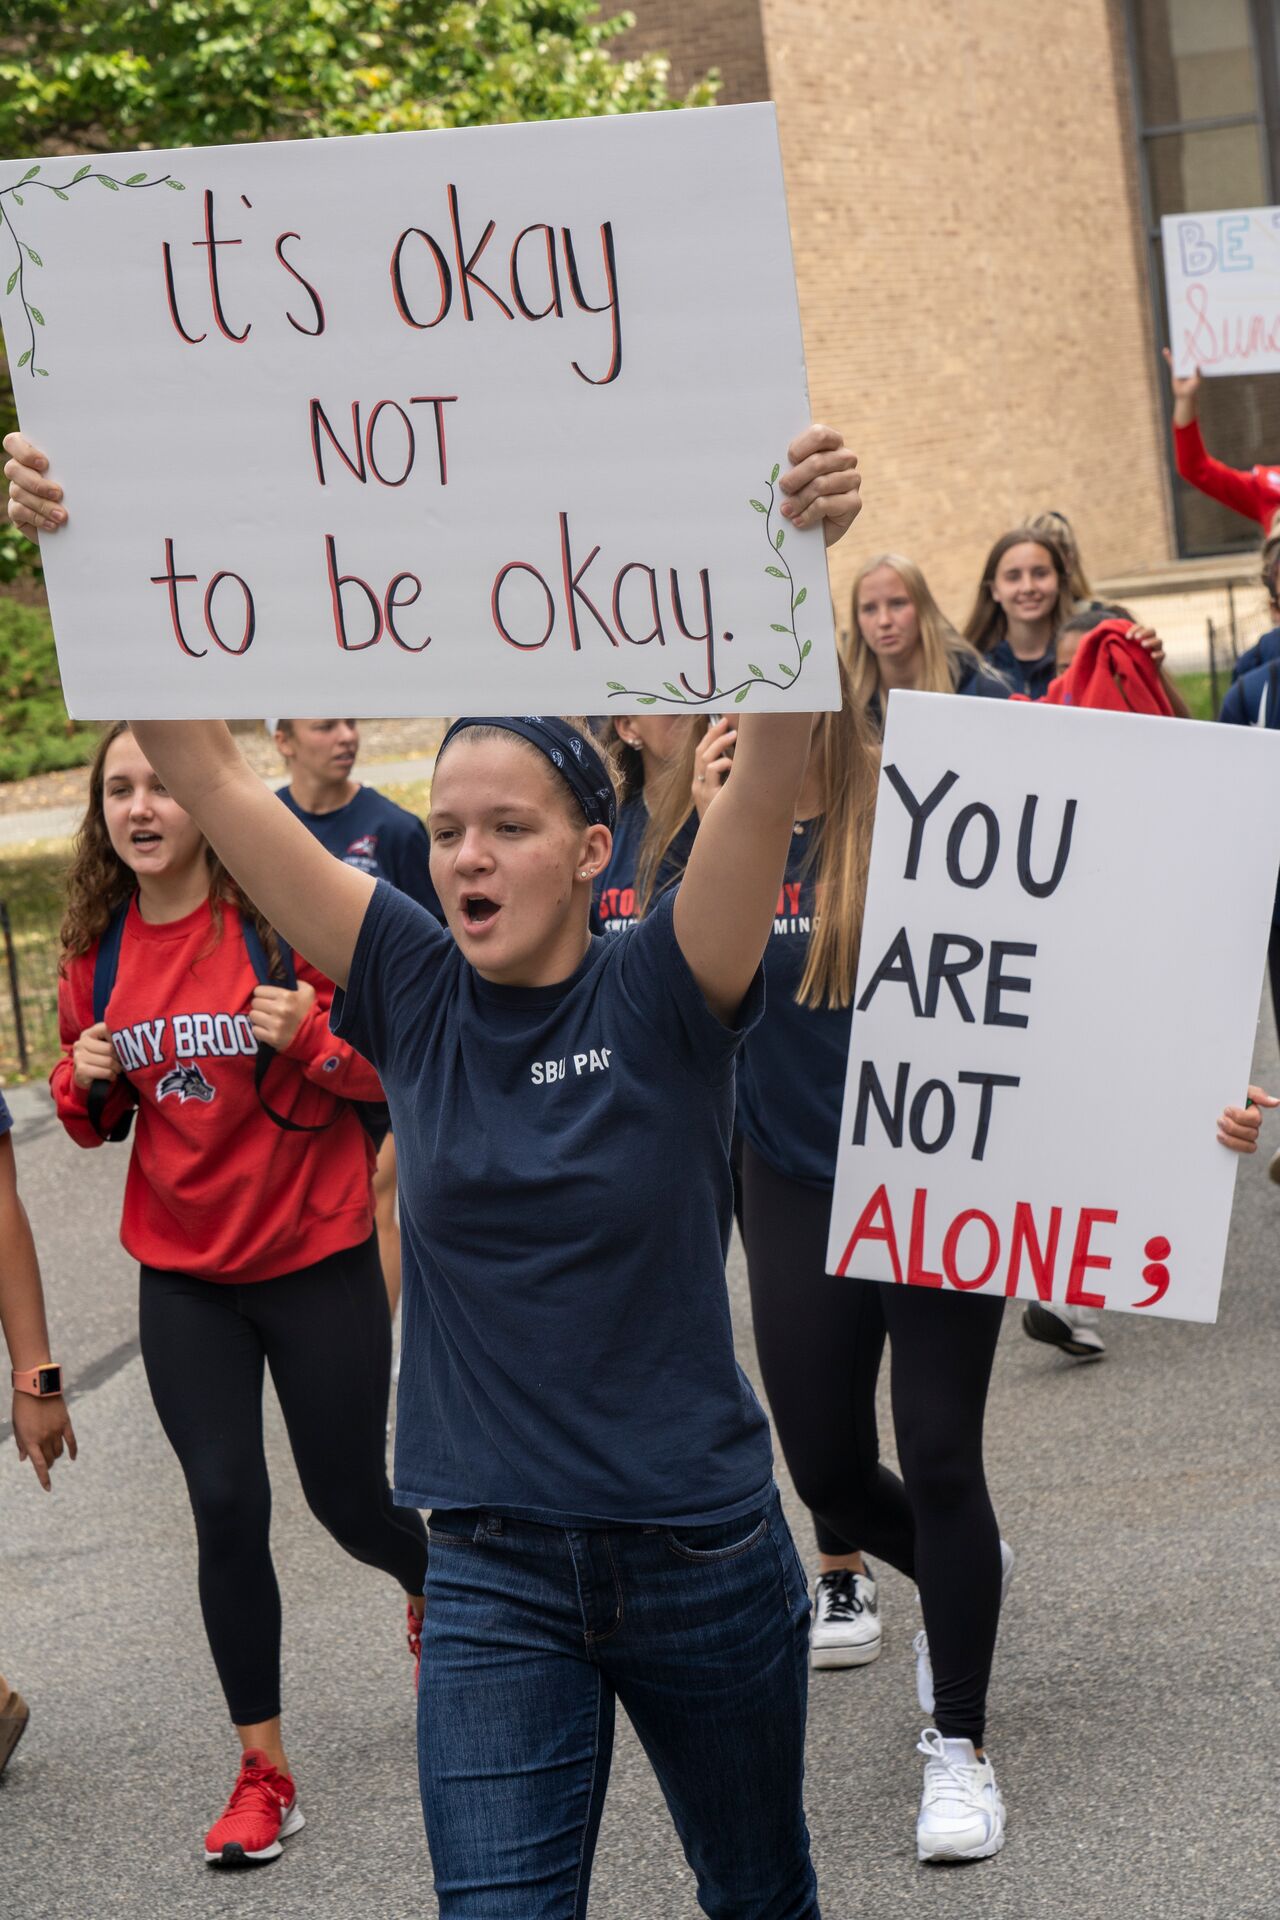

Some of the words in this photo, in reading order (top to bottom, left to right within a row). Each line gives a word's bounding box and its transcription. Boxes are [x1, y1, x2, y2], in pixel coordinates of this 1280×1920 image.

[162, 189, 326, 345] it's
[390, 183, 623, 385] okay
[1178, 215, 1253, 277] BE
[310, 395, 458, 487] NOT
[150, 537, 256, 658] to
[325, 534, 432, 653] be
[491, 511, 734, 699] okay.
[883, 763, 1078, 899] YOU
[856, 926, 1038, 1029] ARE
[530, 1057, 566, 1085] SBU
[852, 1060, 1021, 1162] NOT
